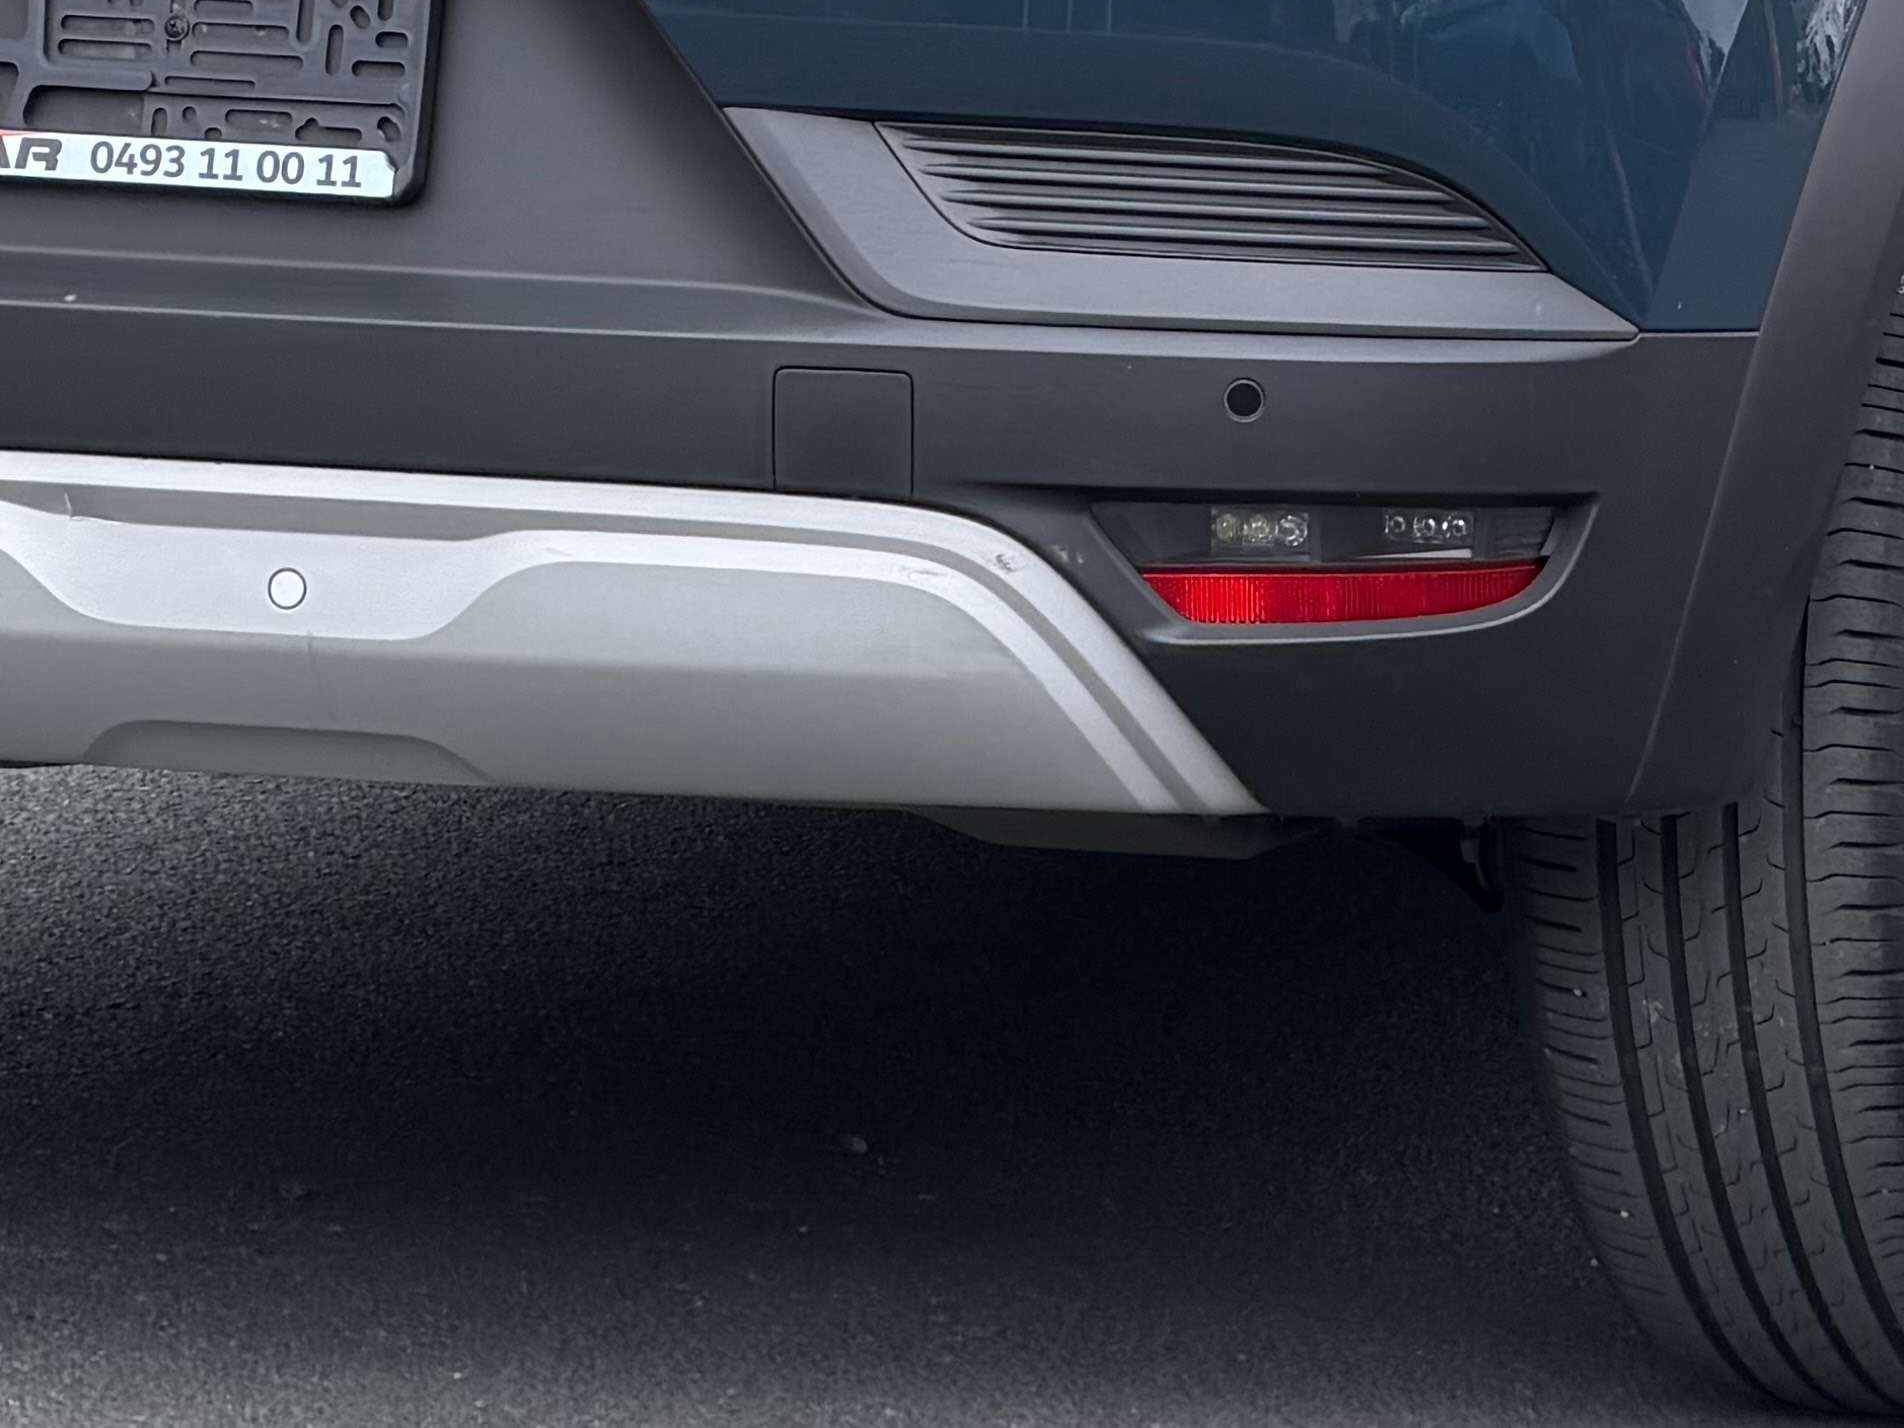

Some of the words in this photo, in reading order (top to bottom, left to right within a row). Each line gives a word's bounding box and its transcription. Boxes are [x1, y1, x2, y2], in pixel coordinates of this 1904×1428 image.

[90, 140, 186, 180] 0493
[198, 145, 244, 182] 11
[256, 148, 305, 186] 00
[315, 151, 363, 189] 11
